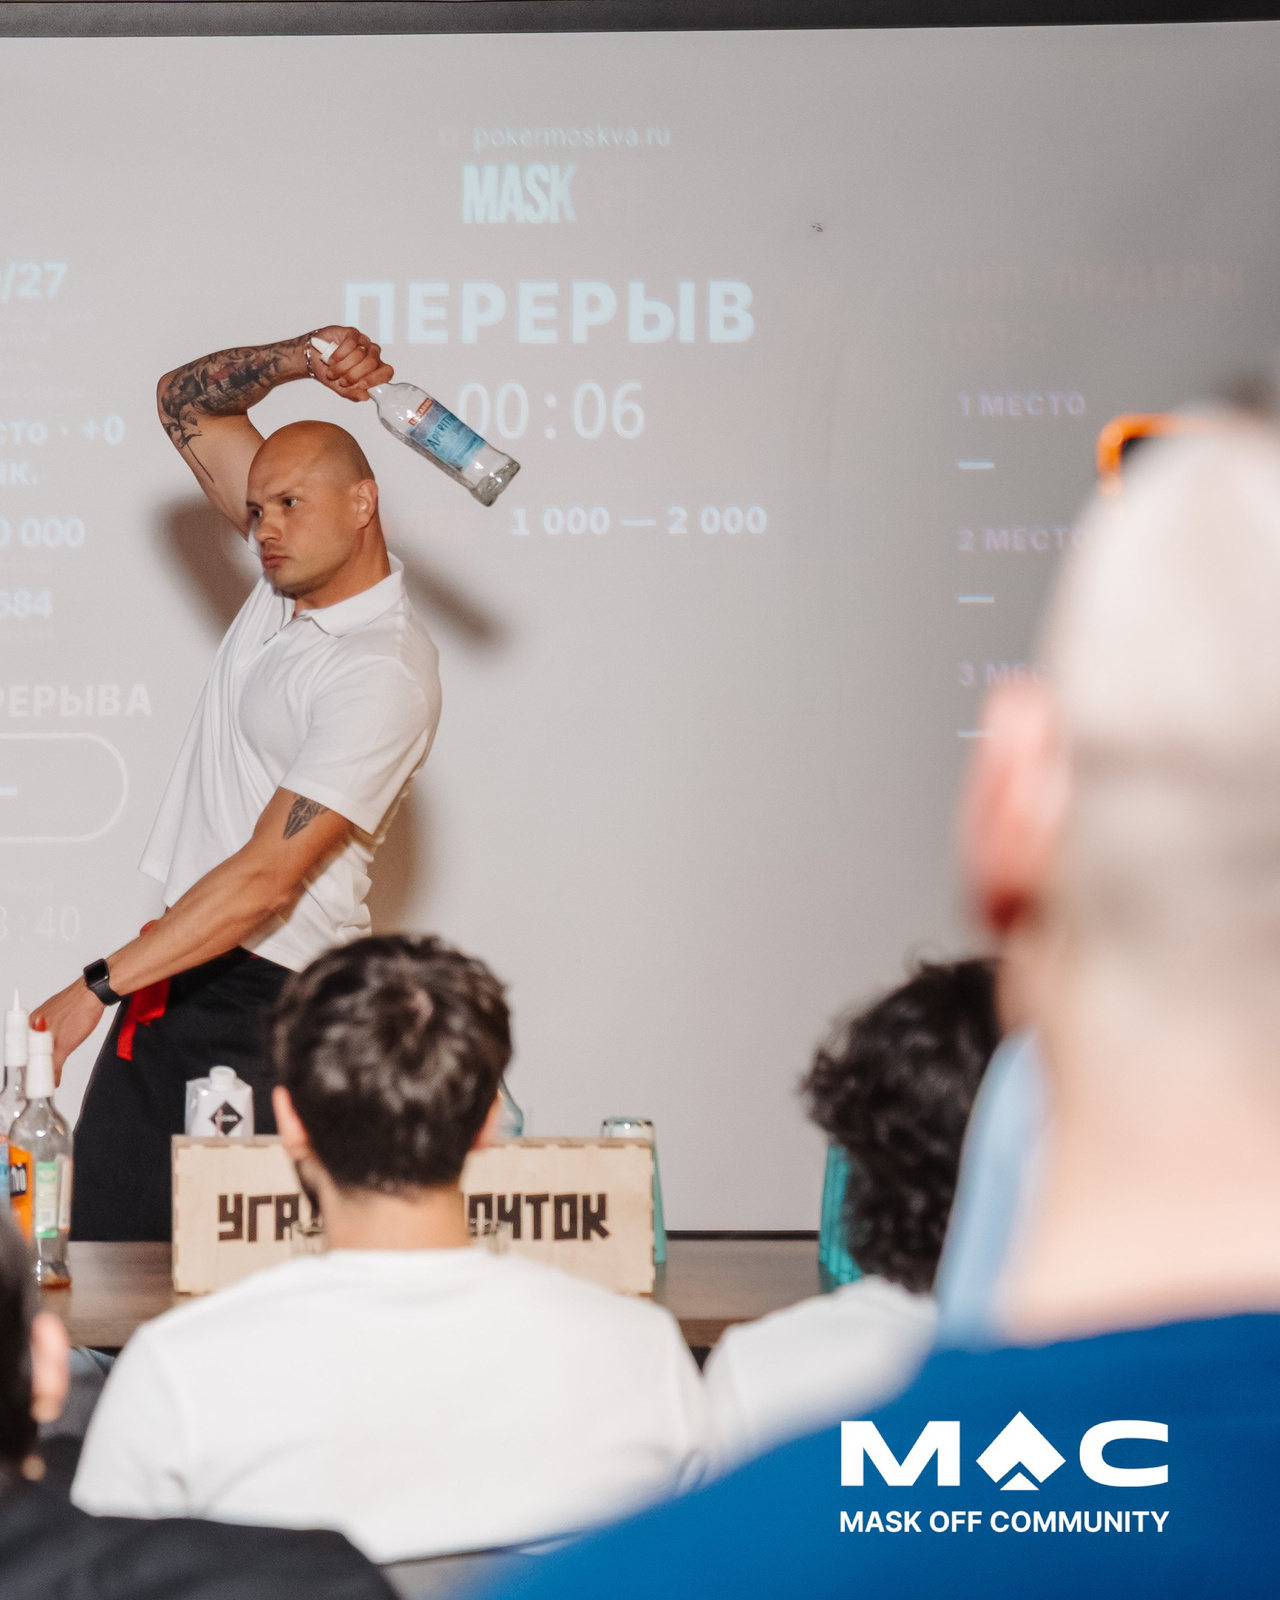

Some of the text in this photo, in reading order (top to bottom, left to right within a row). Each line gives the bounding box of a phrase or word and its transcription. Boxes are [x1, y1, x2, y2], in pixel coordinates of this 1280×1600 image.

[473, 125, 671, 154] pokermoskva.ru
[461, 161, 578, 223] MASK
[343, 279, 756, 345] ПЕРЕРЫВ
[455, 380, 646, 441] 00:06
[978, 391, 1087, 418] МЕСТО
[81, 414, 125, 446] +0
[541, 505, 610, 535] 000
[698, 504, 768, 535] 000
